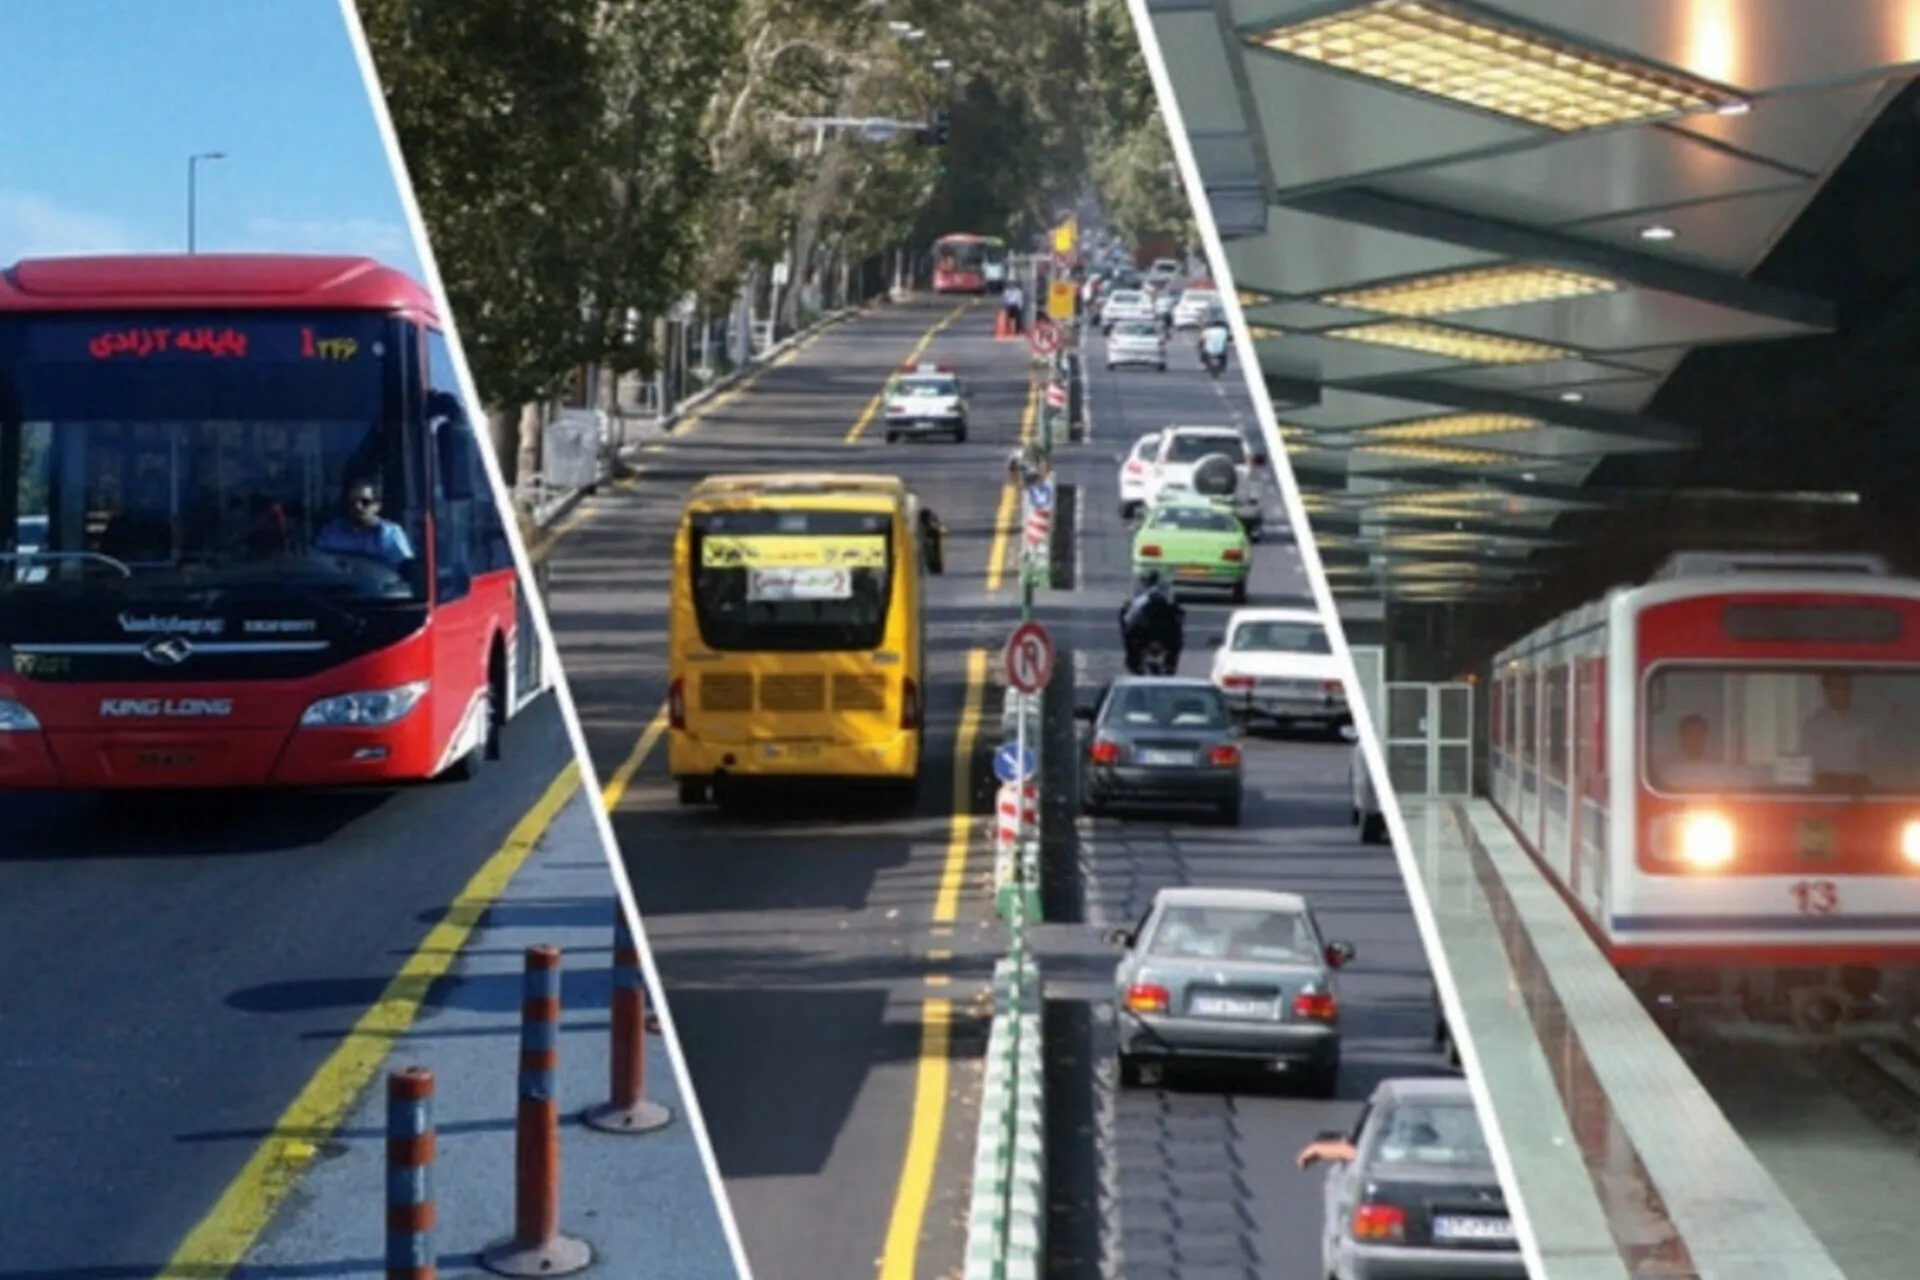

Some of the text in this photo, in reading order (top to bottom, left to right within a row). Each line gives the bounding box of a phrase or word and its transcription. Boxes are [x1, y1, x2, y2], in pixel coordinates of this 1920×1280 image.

[89, 328, 171, 359] آزادی
[99, 698, 234, 716] KING LONG
[1790, 879, 1839, 915] 13
